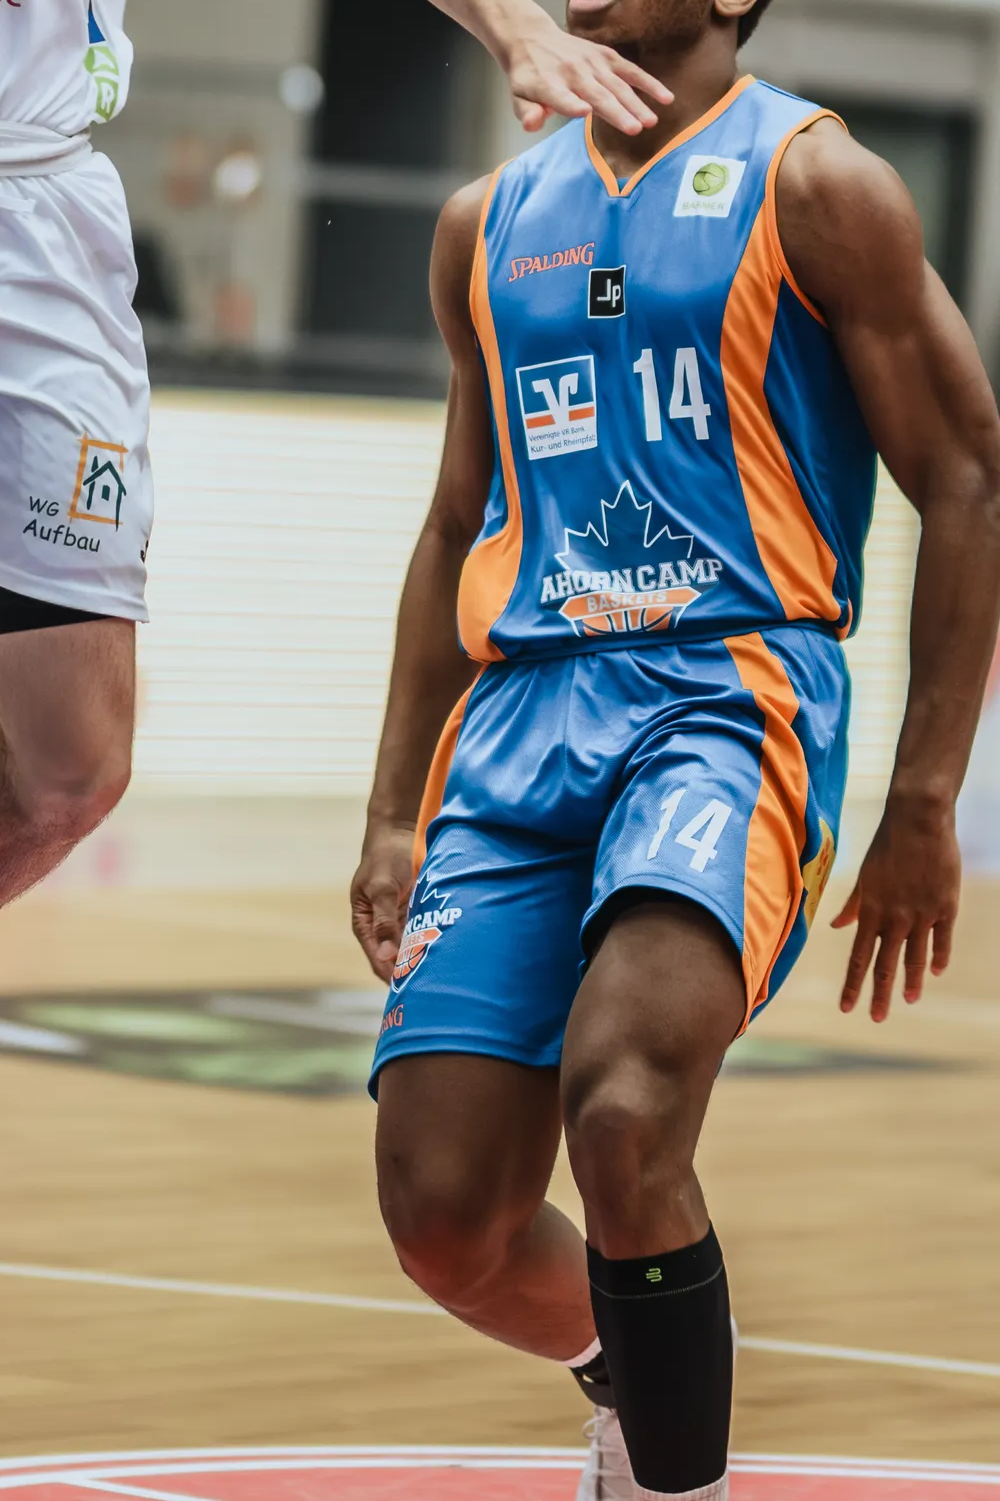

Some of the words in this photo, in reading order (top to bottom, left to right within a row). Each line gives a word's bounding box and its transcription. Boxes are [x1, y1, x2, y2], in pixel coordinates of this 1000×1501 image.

[508, 242, 595, 282] SPALDING
[633, 347, 711, 442] 14
[548, 441, 562, 450] und
[29, 496, 59, 516] WG
[23, 519, 100, 552] Aufbau
[587, 592, 667, 612] BASKETS
[647, 789, 732, 873] 14
